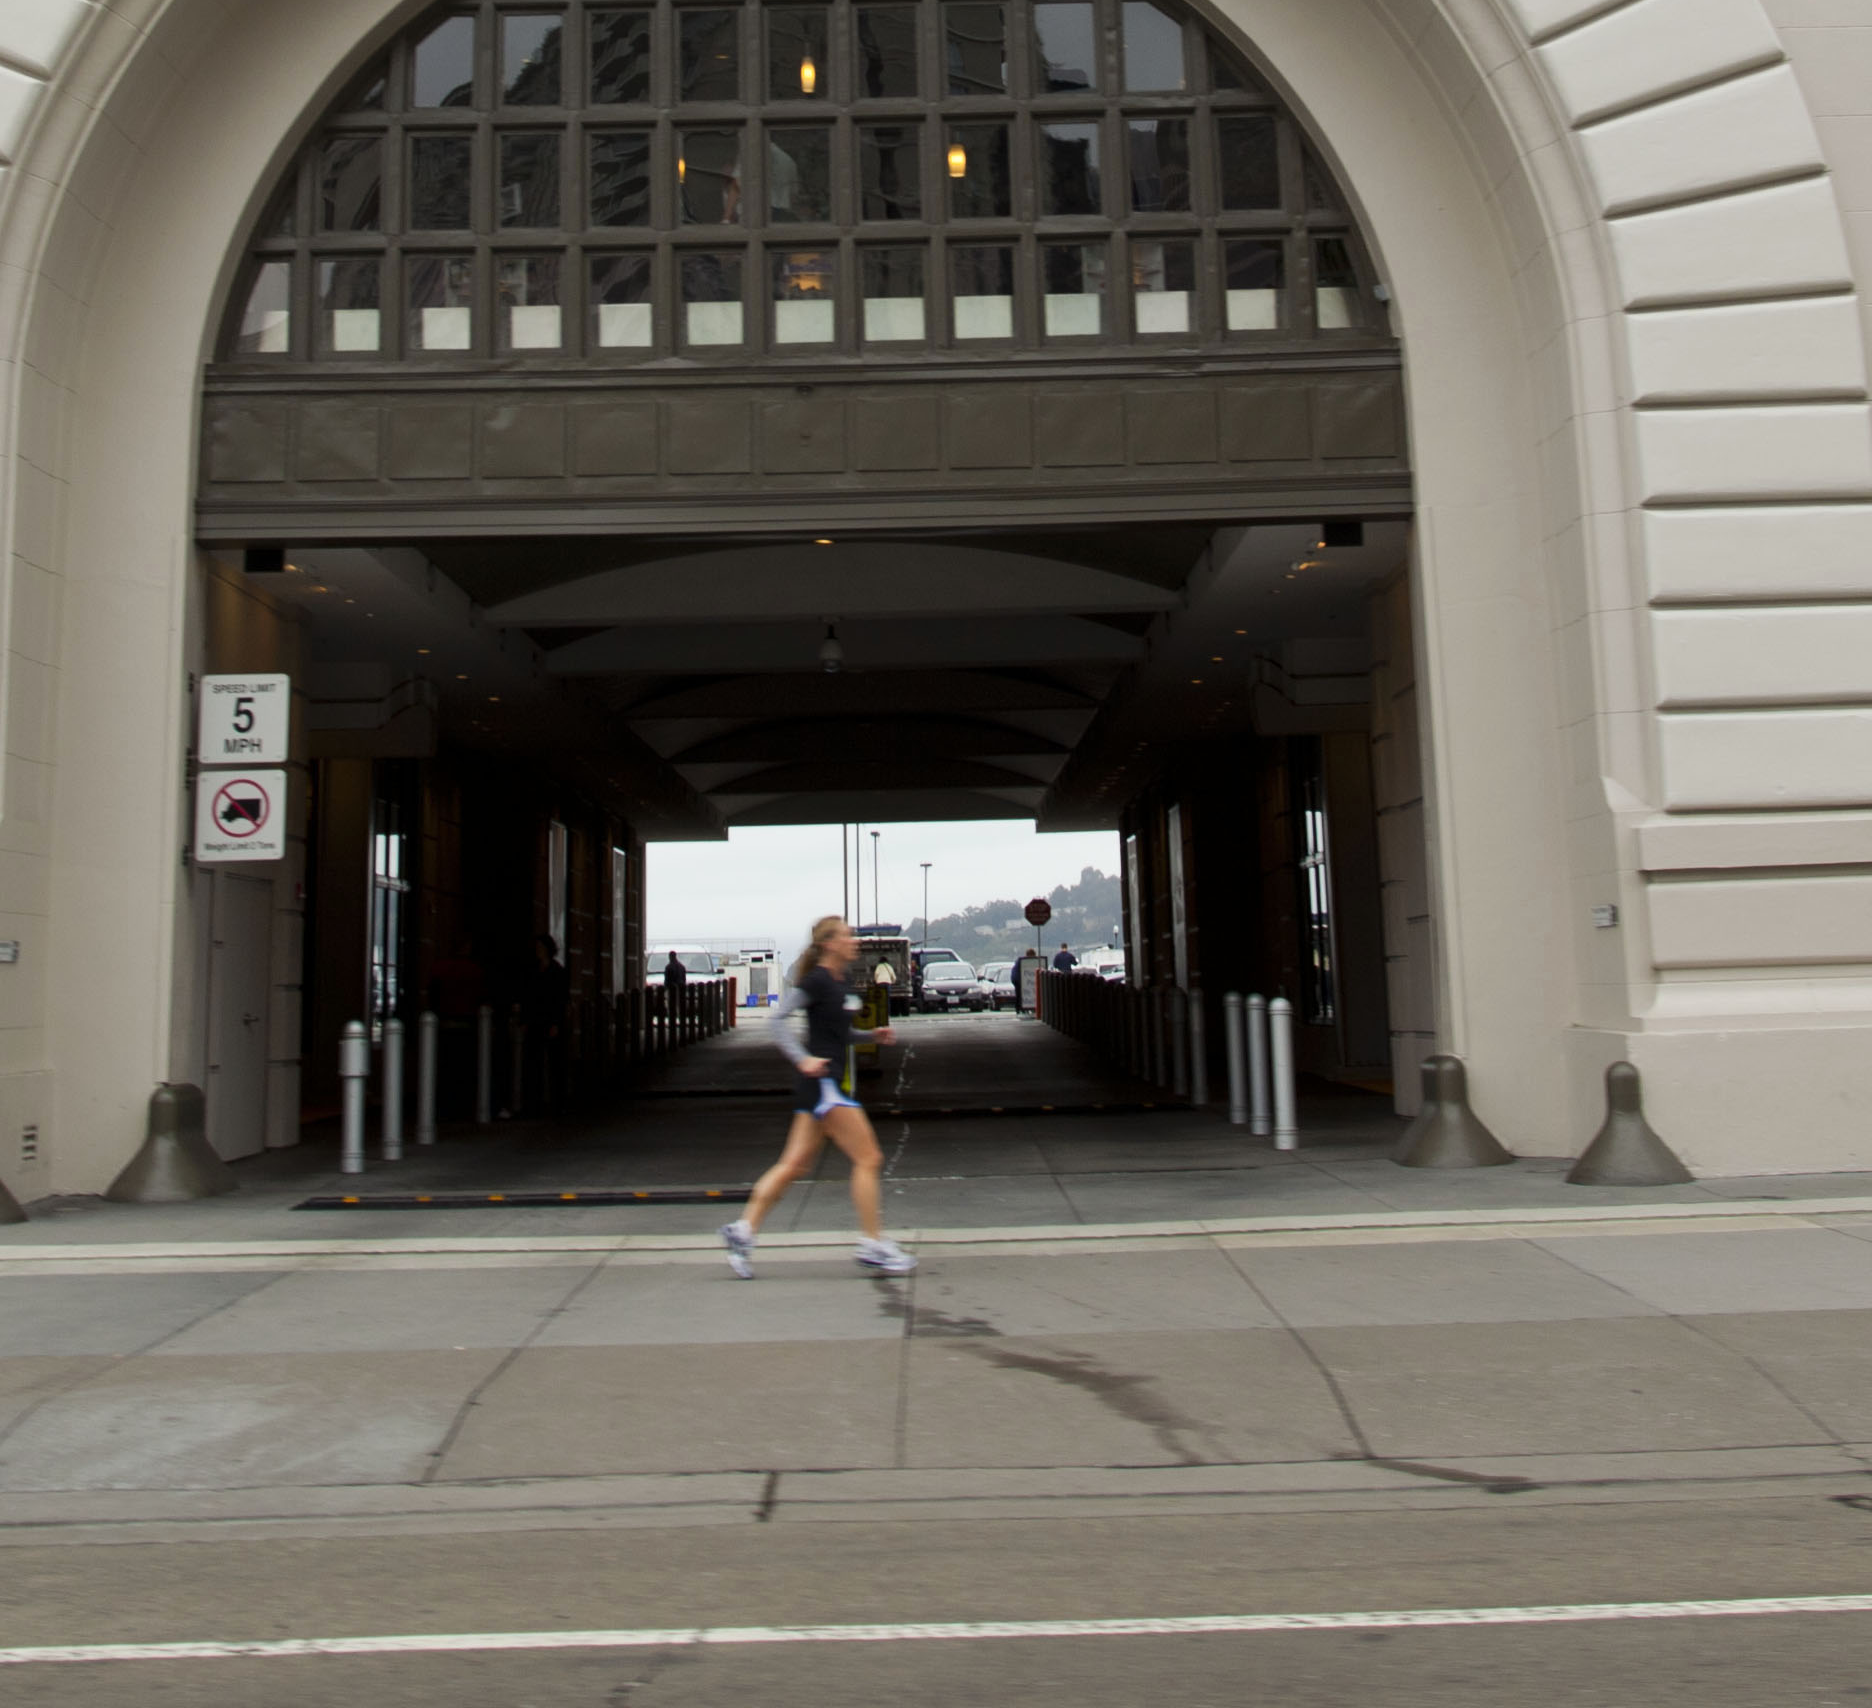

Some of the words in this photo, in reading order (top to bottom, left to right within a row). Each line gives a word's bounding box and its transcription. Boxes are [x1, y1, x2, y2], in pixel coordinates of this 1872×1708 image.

[212, 683, 248, 694] SPEED
[249, 682, 277, 693] LIMIT
[232, 696, 255, 733] 5
[224, 738, 264, 754] MPH
